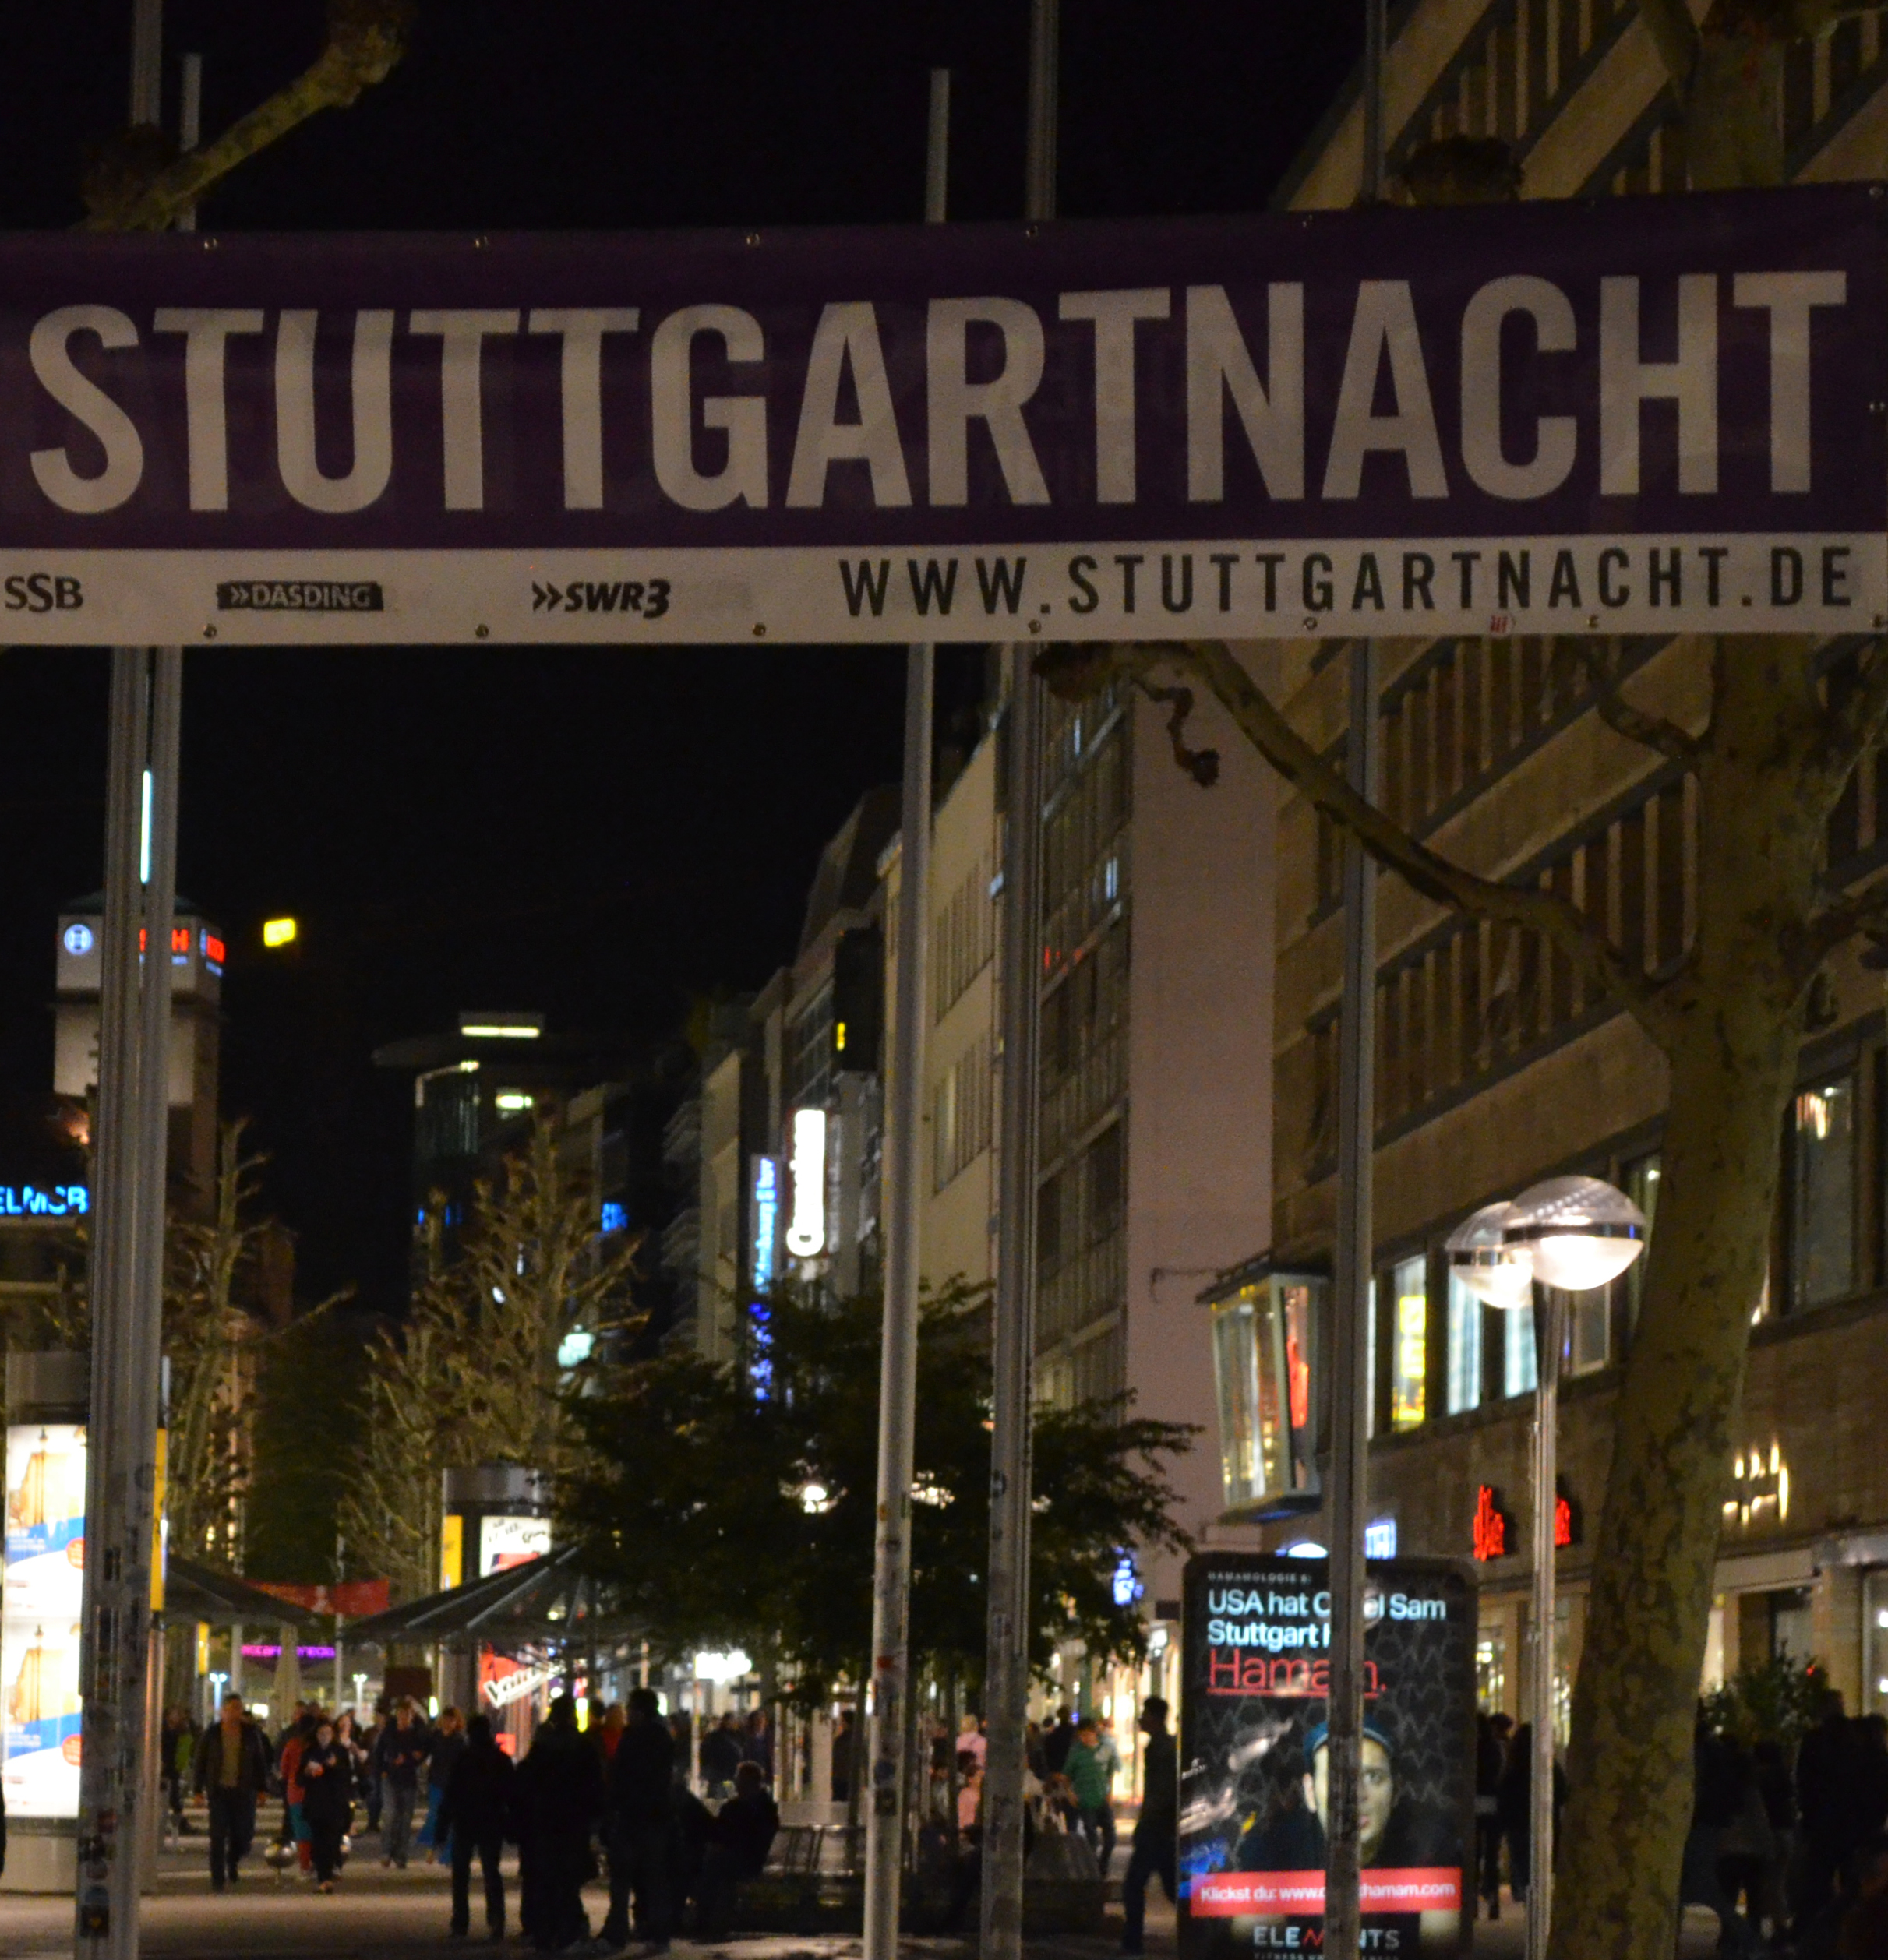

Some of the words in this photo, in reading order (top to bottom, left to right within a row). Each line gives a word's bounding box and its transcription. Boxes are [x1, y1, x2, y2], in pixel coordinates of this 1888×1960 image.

[28, 270, 1847, 514] STUTTGARTNACHT
[4, 573, 83, 613] SSB
[252, 583, 372, 608] DASDING
[564, 577, 671, 619] SWR3
[838, 546, 1852, 615] WWW.STUTTGARTNACHT.DE
[1209, 1589, 1263, 1615] USA
[1269, 1591, 1309, 1616] hat
[1389, 1593, 1446, 1620] Sam
[1208, 1619, 1319, 1652] Stuttgart
[1201, 1886, 1251, 1902] Klickst
